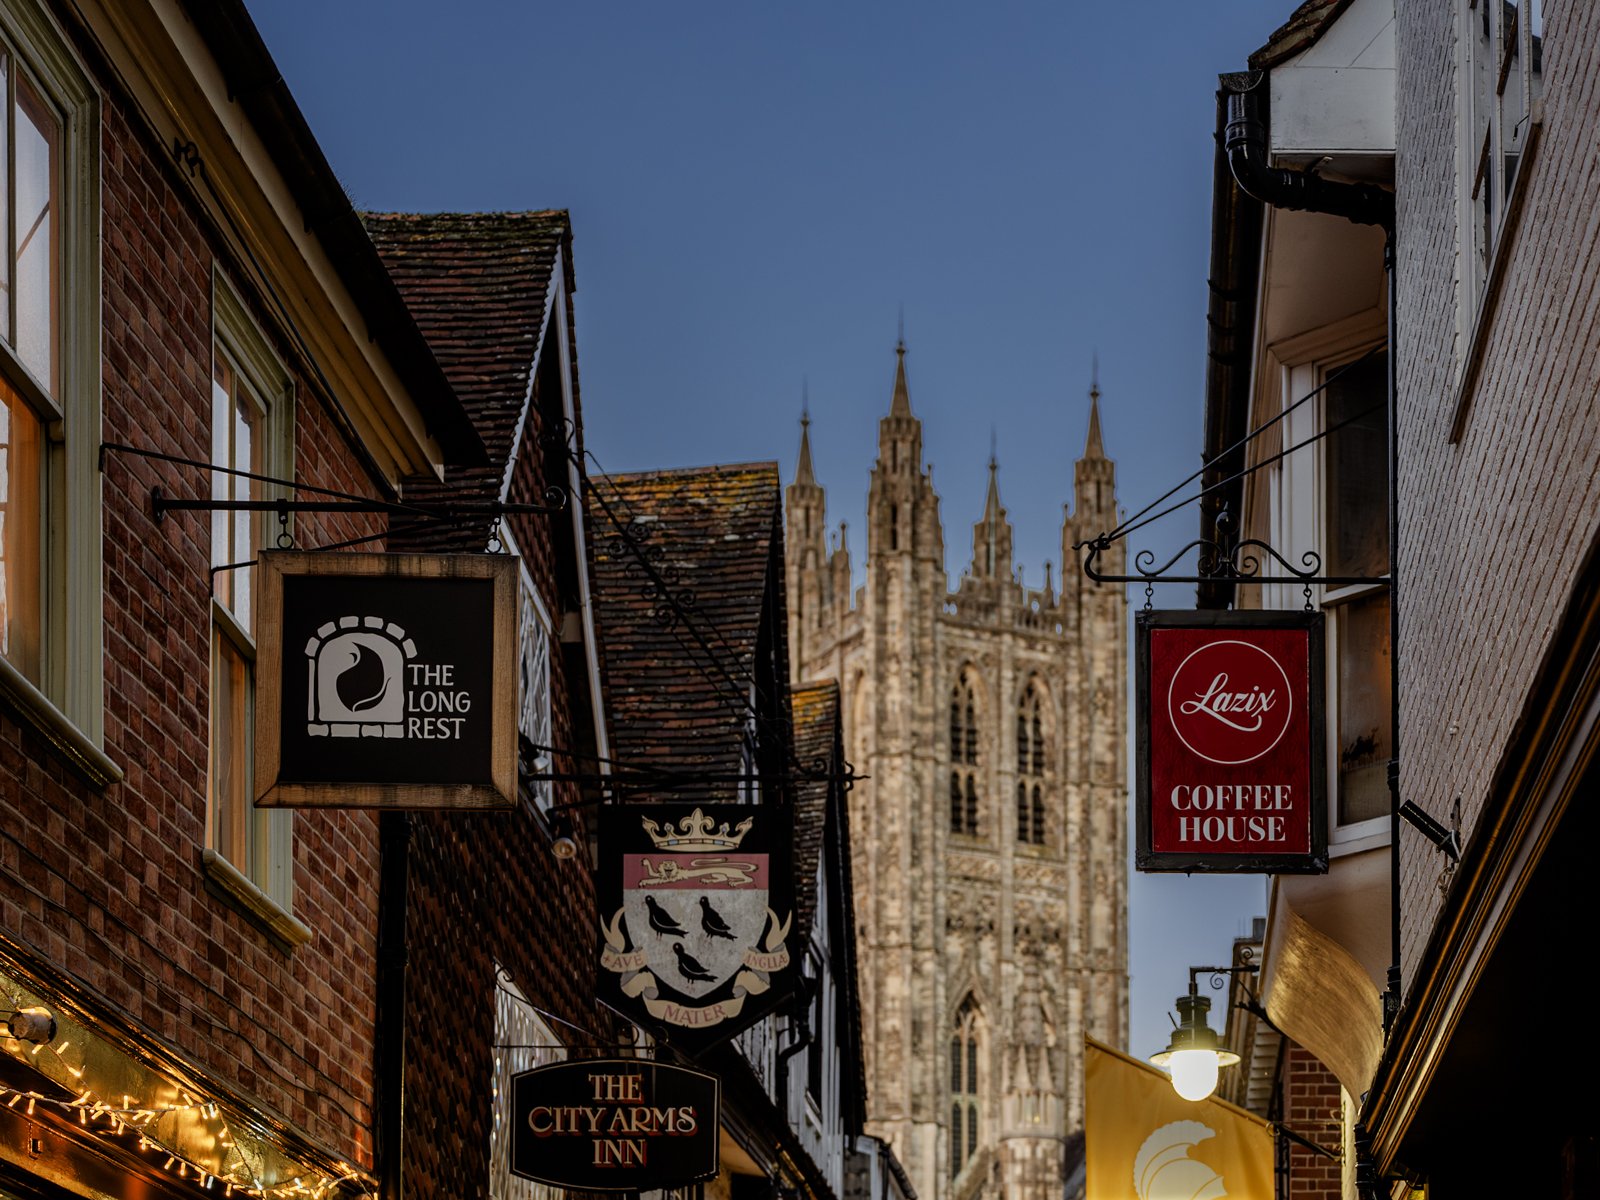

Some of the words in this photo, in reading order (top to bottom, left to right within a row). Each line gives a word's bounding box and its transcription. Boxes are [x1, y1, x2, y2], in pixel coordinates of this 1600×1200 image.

[407, 664, 454, 686] THE
[408, 690, 471, 713] LONG
[1180, 672, 1277, 732] Lazix
[408, 717, 466, 739] REST
[1171, 784, 1293, 811] COFFEE
[1179, 816, 1286, 842] HOUSE
[612, 954, 644, 968] AVE
[663, 1004, 726, 1025] MATER
[588, 1073, 644, 1102] THE
[528, 1105, 606, 1136] CITY
[607, 1105, 697, 1136] ARMS
[592, 1139, 646, 1167] INN
